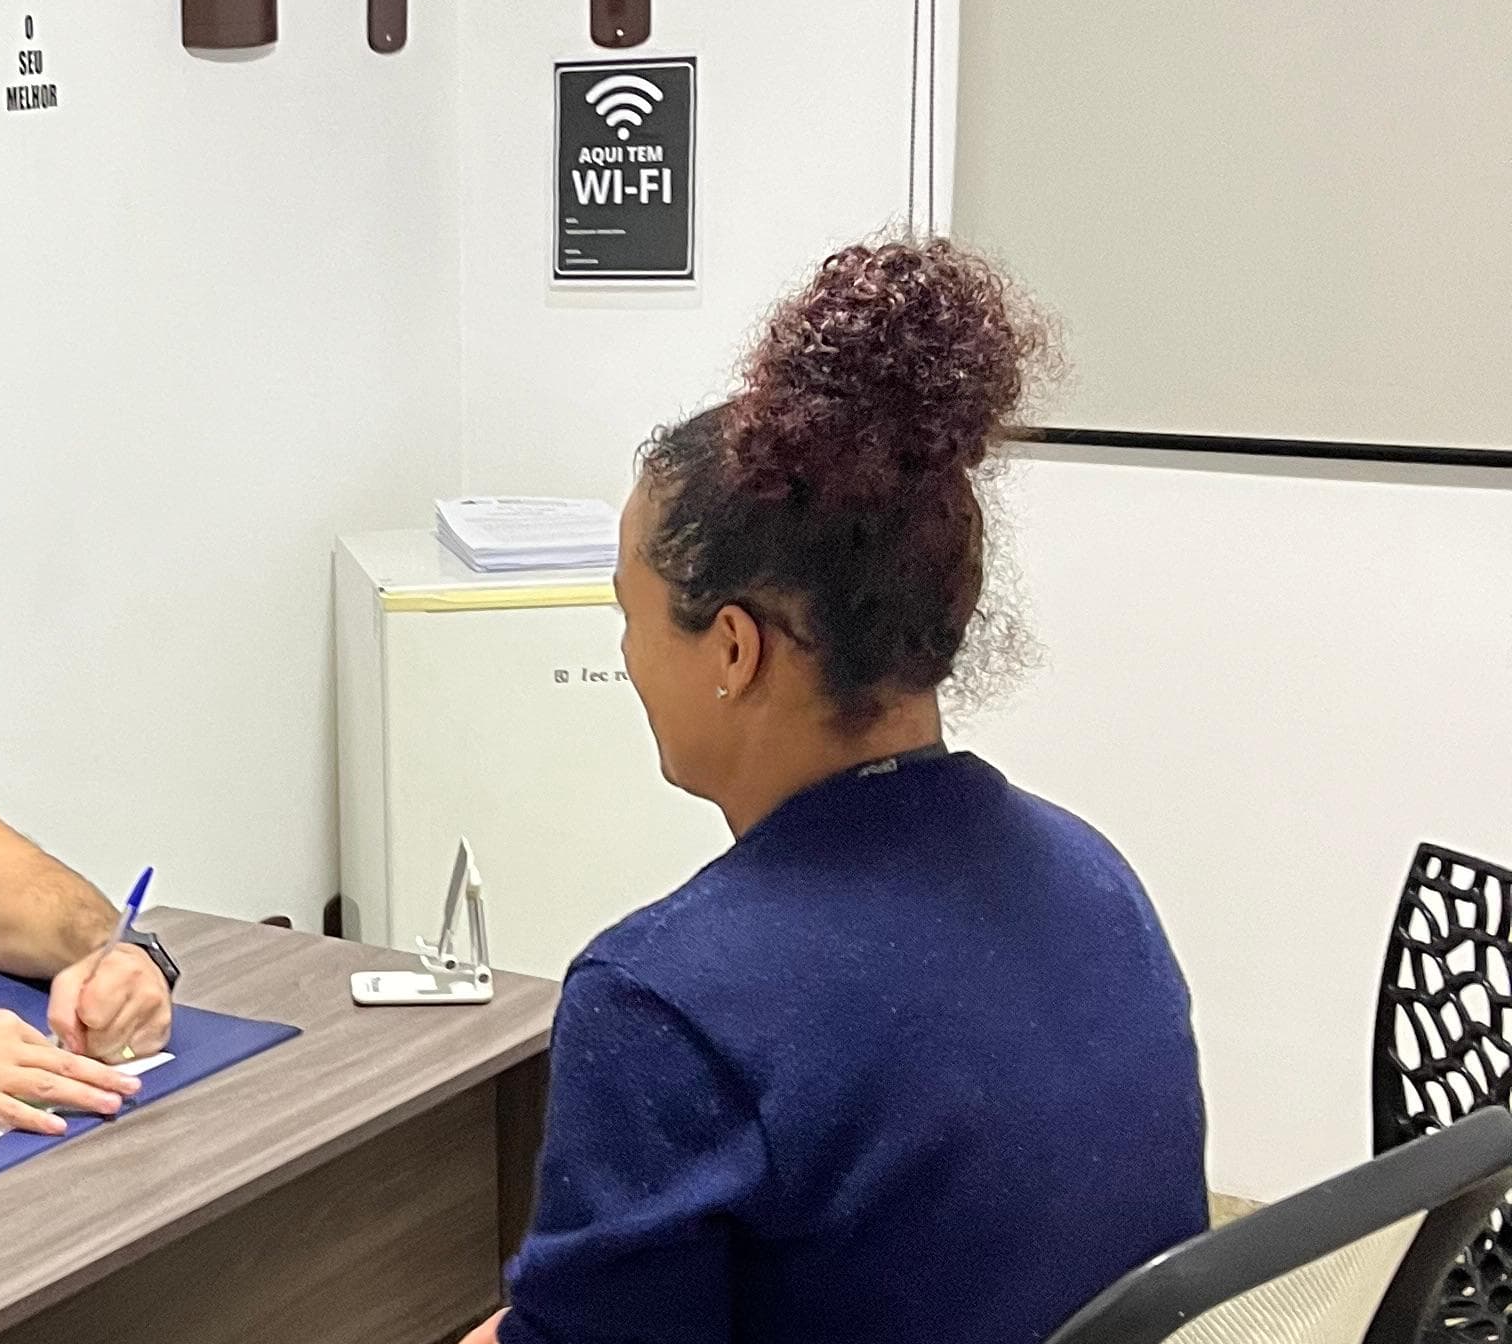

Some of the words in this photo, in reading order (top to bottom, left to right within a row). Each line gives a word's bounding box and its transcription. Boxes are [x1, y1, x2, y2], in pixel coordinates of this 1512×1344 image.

[24, 14, 34, 40] O
[18, 49, 43, 76] SEU
[6, 83, 58, 111] MELHOR
[578, 146, 624, 166] AQUI
[625, 144, 664, 163] TEM
[571, 167, 672, 206] WI-FI
